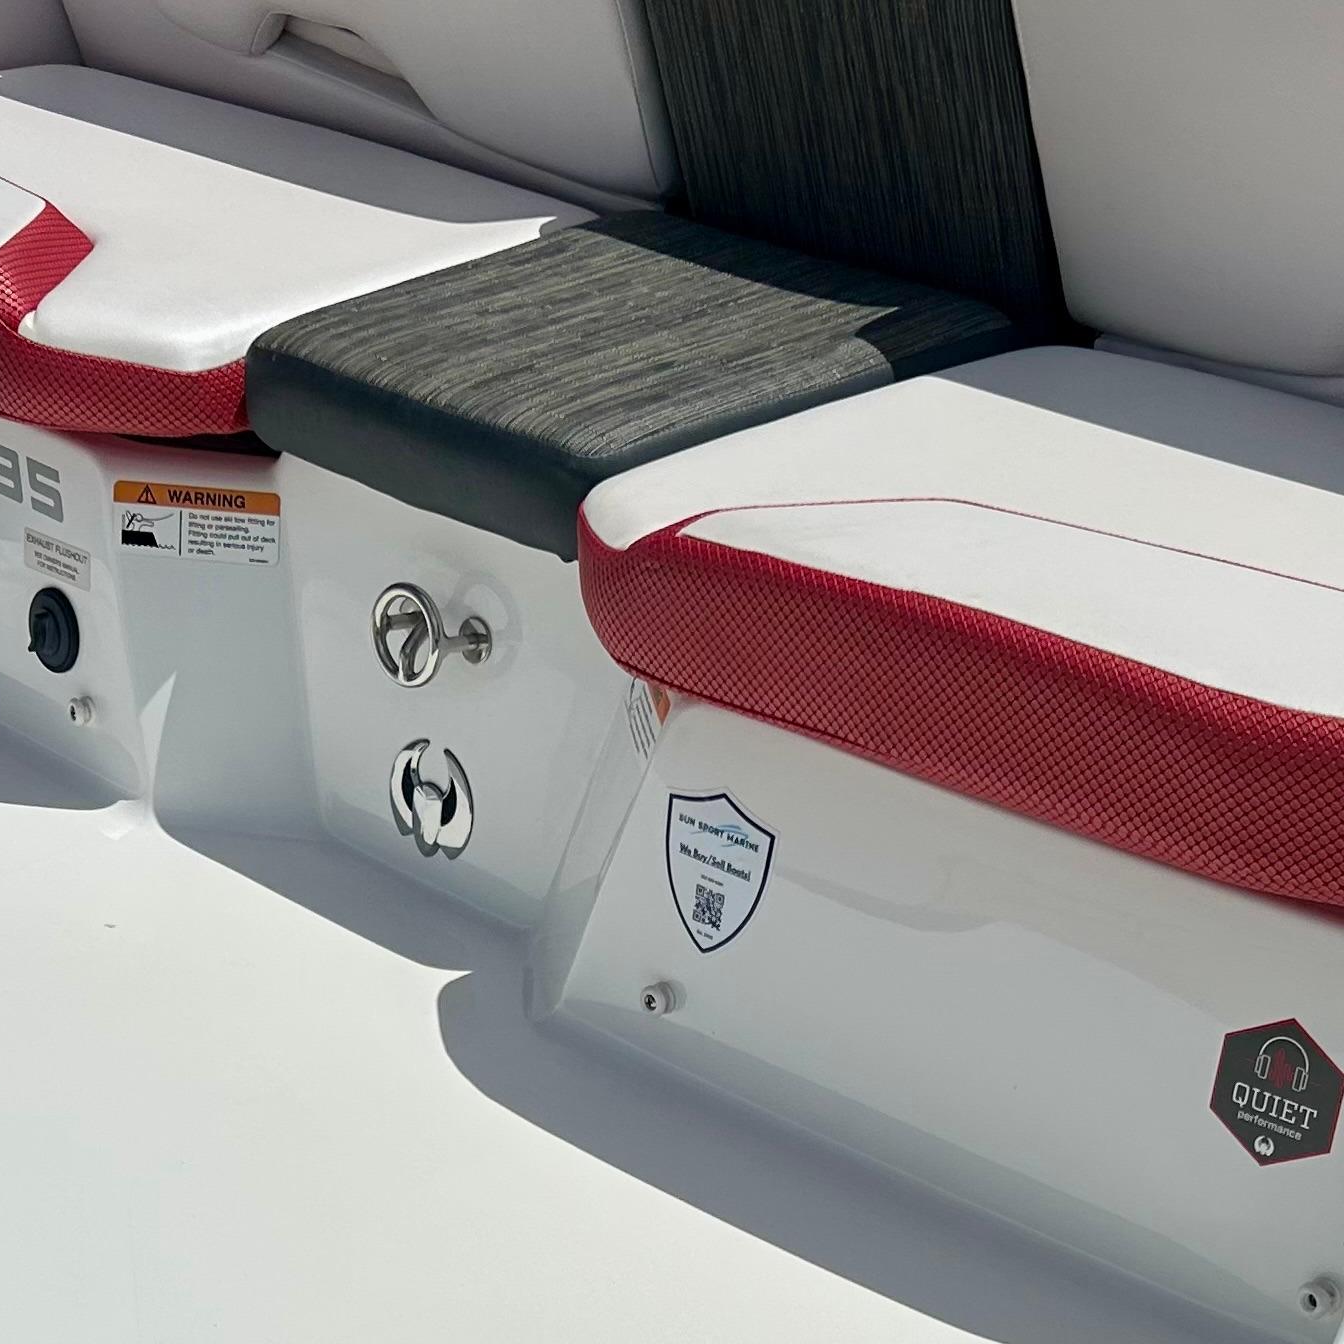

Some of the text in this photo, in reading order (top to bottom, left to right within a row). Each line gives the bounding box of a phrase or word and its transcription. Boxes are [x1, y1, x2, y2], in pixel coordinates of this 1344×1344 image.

[167, 489, 246, 509] WARNING
[679, 813, 760, 853] SUN SPORT MARINE
[1232, 1082, 1317, 1129] QUIET
[1238, 1110, 1302, 1140] performance
